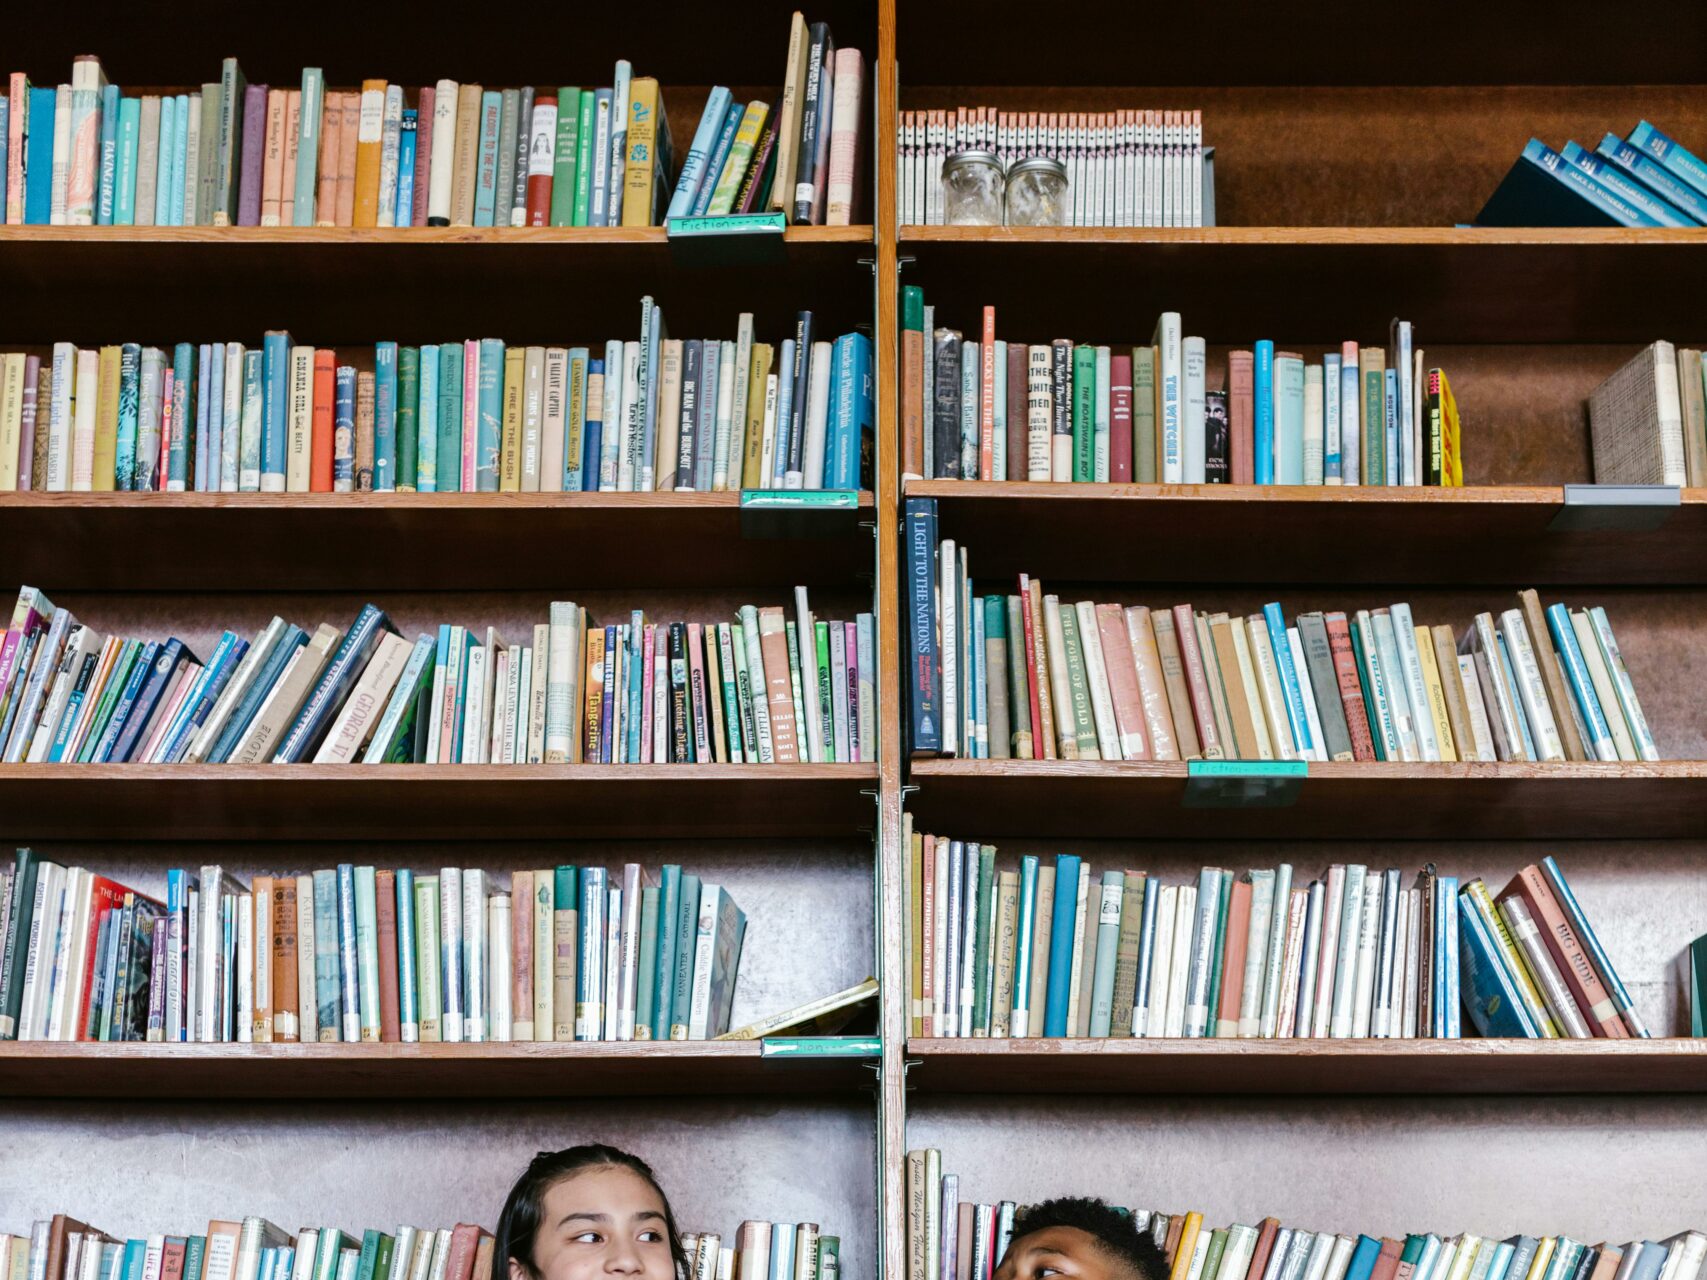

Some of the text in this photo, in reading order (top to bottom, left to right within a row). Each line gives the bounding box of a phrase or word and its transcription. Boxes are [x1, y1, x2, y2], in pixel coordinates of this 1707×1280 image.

[482, 106, 498, 189] FALCONS TO THE FIGHT
[676, 149, 706, 193] Hatchet
[736, 129, 771, 210] ANSWER MY PRAYER
[101, 140, 115, 217] TAKING HOLD
[796, 320, 804, 337] Death
[841, 336, 854, 368] Miracle
[548, 362, 561, 418] VALIANT CAPTIVE
[985, 345, 993, 379] CLOCKS
[1055, 347, 1065, 433] The Night They Burned
[48, 352, 66, 483] Traveling Light BILL BARICH
[138, 373, 153, 448] Roses Are Blue
[637, 336, 649, 458] RIVERS OF ADVENTURE
[701, 349, 715, 454] THE SAPPHIRE PENDANT
[734, 375, 744, 407] PRESENT
[839, 379, 853, 428] Philadelphia
[964, 406, 973, 430] Battle
[983, 408, 992, 426] THE
[984, 383, 992, 405] TELL
[1431, 409, 1439, 418] No
[506, 386, 517, 480] FIRE IN THE BUSH
[680, 381, 695, 469] BIG MAN and the BURN-OUT
[731, 434, 741, 462] PETROS
[733, 411, 742, 432] FROM
[983, 429, 991, 453] TIME
[1081, 403, 1089, 458] BOATSWAIN'S
[1166, 375, 1177, 465] THE WITCHES
[1432, 436, 1440, 452] Dead
[913, 521, 929, 653] LIGHT TO THE NATIONS
[604, 650, 615, 674] WHITE
[1179, 608, 1190, 628] THREE
[1185, 631, 1197, 665] WITHOUT
[604, 674, 613, 693] STAR
[1062, 612, 1087, 726] THE FORT OF GOLD
[1370, 653, 1391, 733] YELLOW IS THE
[588, 691, 601, 749] Tangerine
[1432, 683, 1451, 749] Robinson Crusoe
[26, 882, 45, 985] ASHTON WORDS CAN TELL
[303, 896, 313, 961] KATIE JOHN
[998, 896, 1014, 1004] First Orchid for Pat
[1556, 923, 1576, 950] BIG
[1571, 952, 1596, 988] RIDE
[696, 944, 710, 1016] Caddie Woodlawn
[911, 1159, 923, 1186] Justin
[912, 1190, 924, 1232] Morgan
[146, 1253, 157, 1271] LIFE
[913, 1236, 924, 1259] Had
